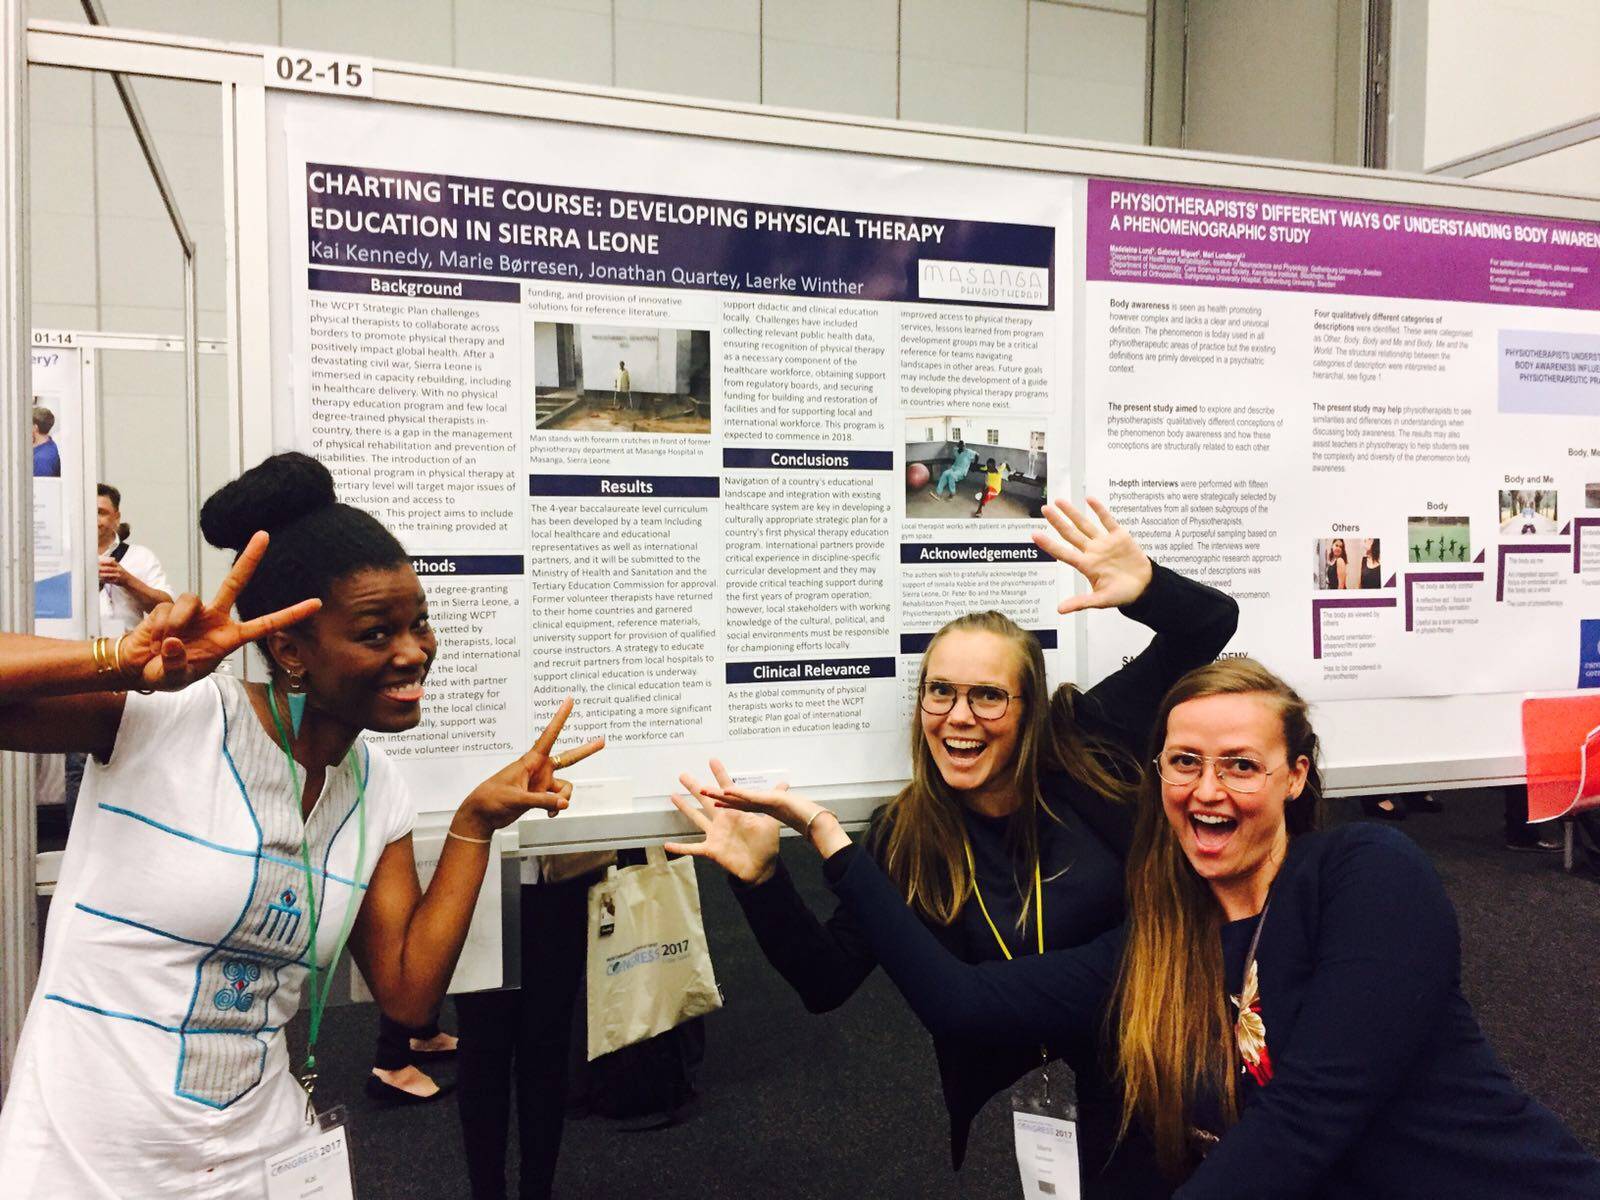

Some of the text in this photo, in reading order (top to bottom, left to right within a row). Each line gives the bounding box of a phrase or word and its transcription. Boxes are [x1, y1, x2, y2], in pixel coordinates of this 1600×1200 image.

[276, 56, 363, 88] 02-15
[308, 171, 945, 243] CHARTING THE COURSE: DEVELOPING PHYSICAL THERAPY
[1110, 191, 1600, 248] PHYSIOTHERAPISTS' DIFFERENT WAYS OF UNDERSTANDING BODY AWAREN
[310, 206, 659, 255] EDUCATION IN SIERRA LEONE
[1110, 214, 1311, 243] A PHENOMENOGRAPHIC STUDY
[311, 240, 864, 295] Kai Kennedy, Marie Børresen, Jonathan Quartey, Laerke Winther
[924, 264, 1042, 288] MASANGA
[371, 278, 462, 297] Background
[527, 287, 682, 305] funding, and provision of innovative
[310, 298, 480, 320] The WCPT Strategic Plan challenges
[1109, 298, 1130, 310] Body
[1130, 301, 1170, 311] awareness
[1207, 304, 1226, 312] health
[1228, 306, 1262, 316] promoting
[309, 313, 500, 332] physical therapists to collaborate across
[1313, 308, 1330, 318] Four
[1331, 310, 1371, 322] qualitatively
[1371, 312, 1400, 322] different
[1400, 314, 1434, 325] categories
[34, 333, 72, 344] 01-14
[900, 323, 1044, 339] services, lessons learned from program
[1515, 361, 1534, 370] BODY
[1535, 362, 1576, 372] AWARENESS
[1519, 373, 1588, 384] PHYSIOTHERAPEUTIC
[1107, 401, 1122, 412] The
[1123, 403, 1152, 413] present
[1152, 403, 1174, 414] study
[1174, 404, 1198, 413] aimed
[1206, 405, 1233, 414] explore
[1234, 405, 1246, 413] and
[1247, 405, 1275, 414] describe
[1312, 401, 1326, 411] The
[1326, 404, 1352, 413] present
[1352, 404, 1371, 414] study
[1371, 405, 1386, 415] may
[1387, 405, 1402, 415] help
[1402, 406, 1451, 415] physiotherapists
[529, 434, 547, 442] Man
[547, 434, 572, 442] stands
[572, 435, 590, 443] with
[590, 435, 620, 444] forearm
[659, 437, 678, 445] front
[687, 437, 711, 446] former
[771, 453, 849, 467] Conclusions
[1568, 448, 1589, 457] Body,
[601, 480, 653, 494] Results
[724, 476, 769, 487] Navigation
[770, 476, 780, 485] of
[788, 477, 826, 487] country's
[827, 477, 874, 486] educational
[1108, 478, 1269, 489] In-depth interviews were performed with fifteen
[1504, 475, 1554, 484] Body and Me
[530, 503, 708, 514] The 4-year baccalaureate level curriculum
[1427, 502, 1448, 512] Body
[945, 522, 964, 530] works
[978, 522, 1000, 530] patient
[1332, 523, 1360, 532] Others
[920, 547, 1038, 562] Acknowledgements
[412, 559, 456, 573] thods
[753, 664, 871, 679] Clinical Relevance
[727, 684, 867, 699] As the global community of physical
[661, 939, 689, 956] 2017
[1055, 1129, 1073, 1139] 2017
[320, 1139, 341, 1156] 2017
